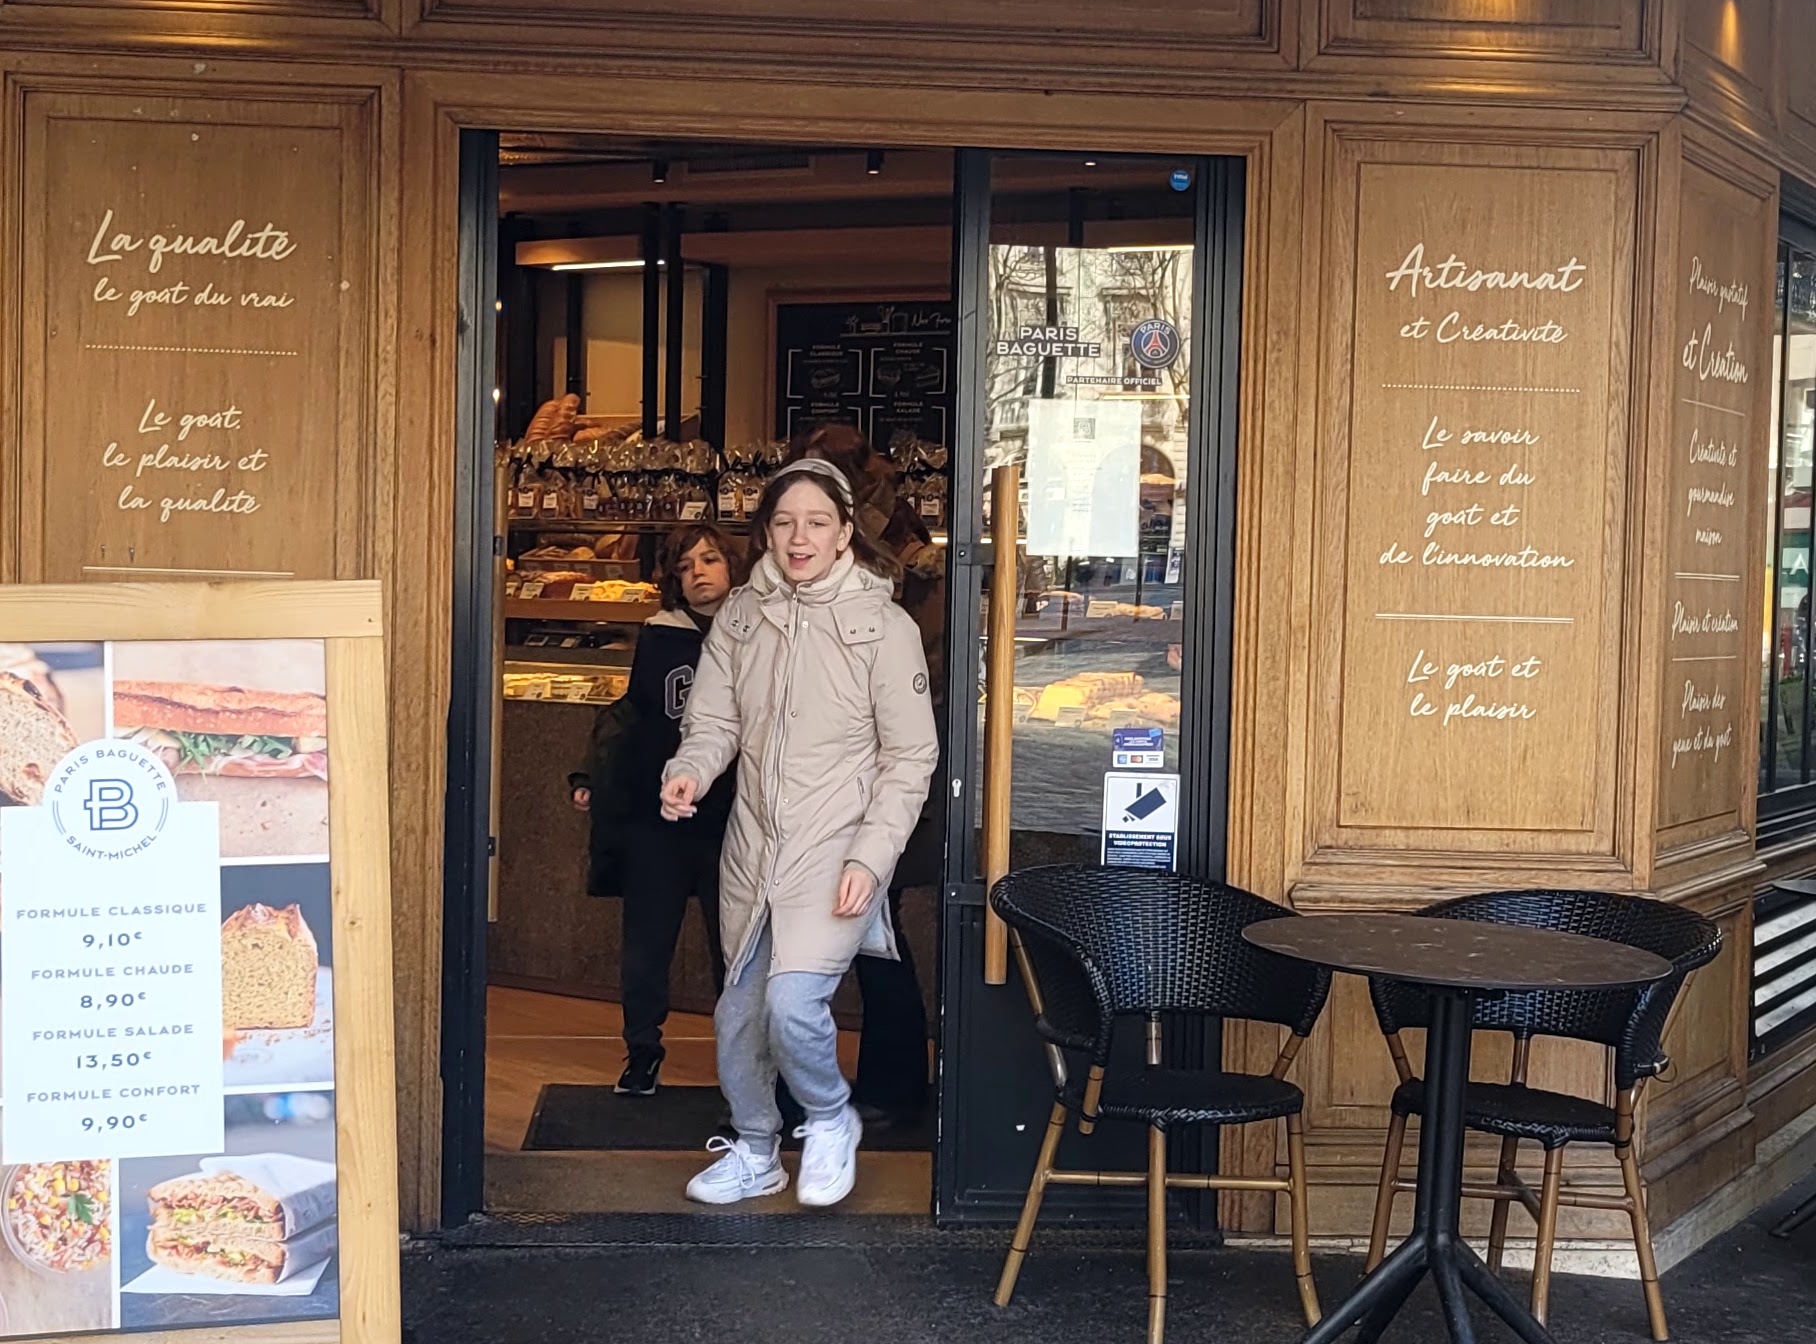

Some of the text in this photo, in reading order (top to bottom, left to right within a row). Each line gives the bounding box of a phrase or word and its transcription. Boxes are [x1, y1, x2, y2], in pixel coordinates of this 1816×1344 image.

[87, 209, 297, 273] La qualité
[1385, 242, 1587, 298] Artisanat
[1689, 256, 1719, 297] Plaisir
[93, 277, 123, 301] le
[194, 283, 232, 305] du
[241, 292, 295, 308] vrai
[1020, 327, 1078, 341] PARIS
[1140, 322, 1171, 335] PARIS
[1400, 311, 1568, 343] et Créativité
[996, 341, 1100, 357] BAGUETTE
[1683, 328, 1699, 370] et
[1067, 376, 1162, 385] PARTENAIRE OFFICIEL
[138, 399, 172, 433] Le
[1422, 416, 1541, 449] Le savoir
[103, 442, 269, 477] le plaisir et
[1728, 443, 1738, 467] et
[1421, 461, 1536, 496] faire du
[118, 485, 261, 523] la qualité
[1490, 504, 1521, 527] et
[1379, 541, 1575, 568] de l'innovation
[1671, 601, 1701, 641] Plaisir
[1701, 608, 1711, 633] et
[1407, 649, 1439, 683] Le
[1511, 656, 1542, 678] et
[665, 664, 694, 719] G
[1682, 680, 1711, 719] Plaisir
[1410, 693, 1536, 726] le plaisir
[1693, 726, 1703, 750] et
[54, 749, 167, 793] PARIS BAGUETTE
[66, 834, 158, 860] SAINT-MICHEL
[16, 903, 207, 920] FORMULE CLASSIQUE
[82, 931, 143, 950] 9,10€
[31, 964, 194, 980] FORMULE CHAUDE
[80, 992, 146, 1010] 8,90€
[32, 1024, 194, 1041] FORMULE SALADE
[76, 1051, 152, 1071] 13,50€
[27, 1084, 201, 1103] FORMULE CONFORT
[81, 1113, 148, 1133] 9,90€
